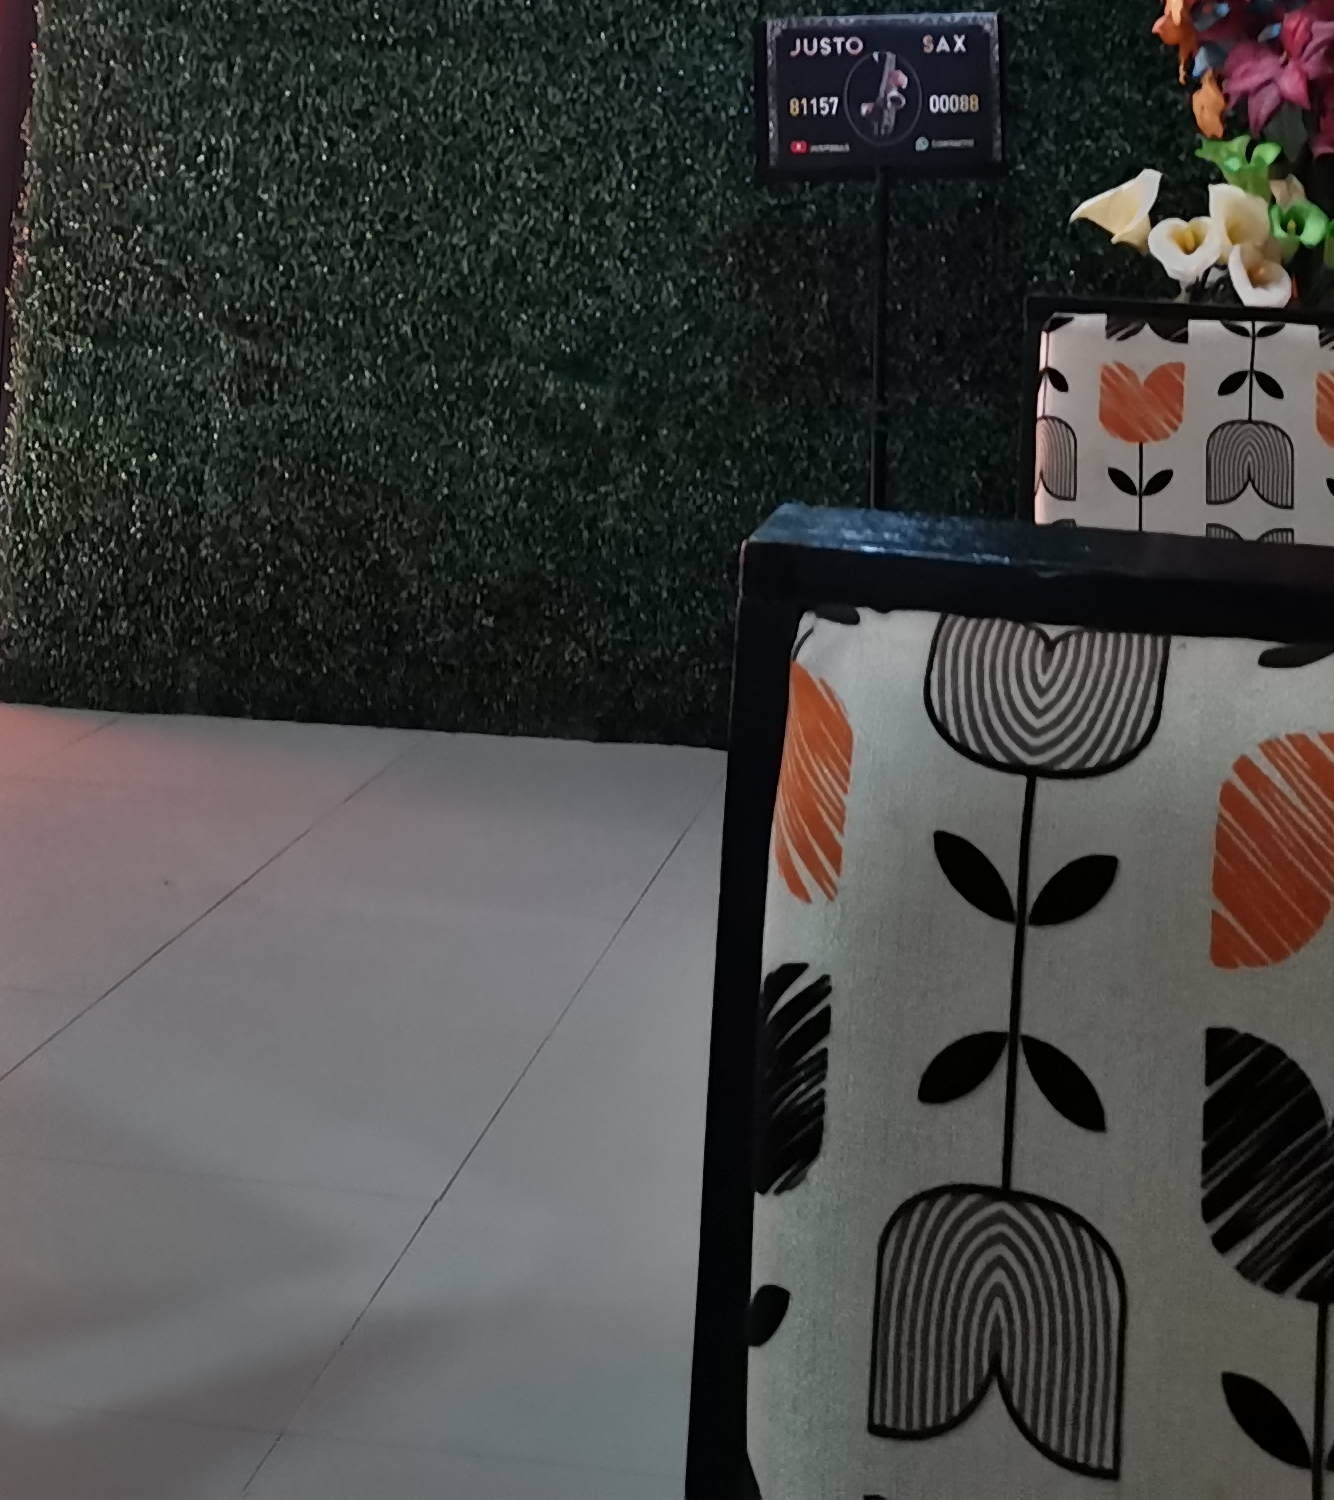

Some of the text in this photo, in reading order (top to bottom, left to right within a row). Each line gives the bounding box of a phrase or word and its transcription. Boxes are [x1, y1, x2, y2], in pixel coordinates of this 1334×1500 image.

[789, 33, 967, 59] JUSTO SAX
[789, 95, 840, 118] 81157
